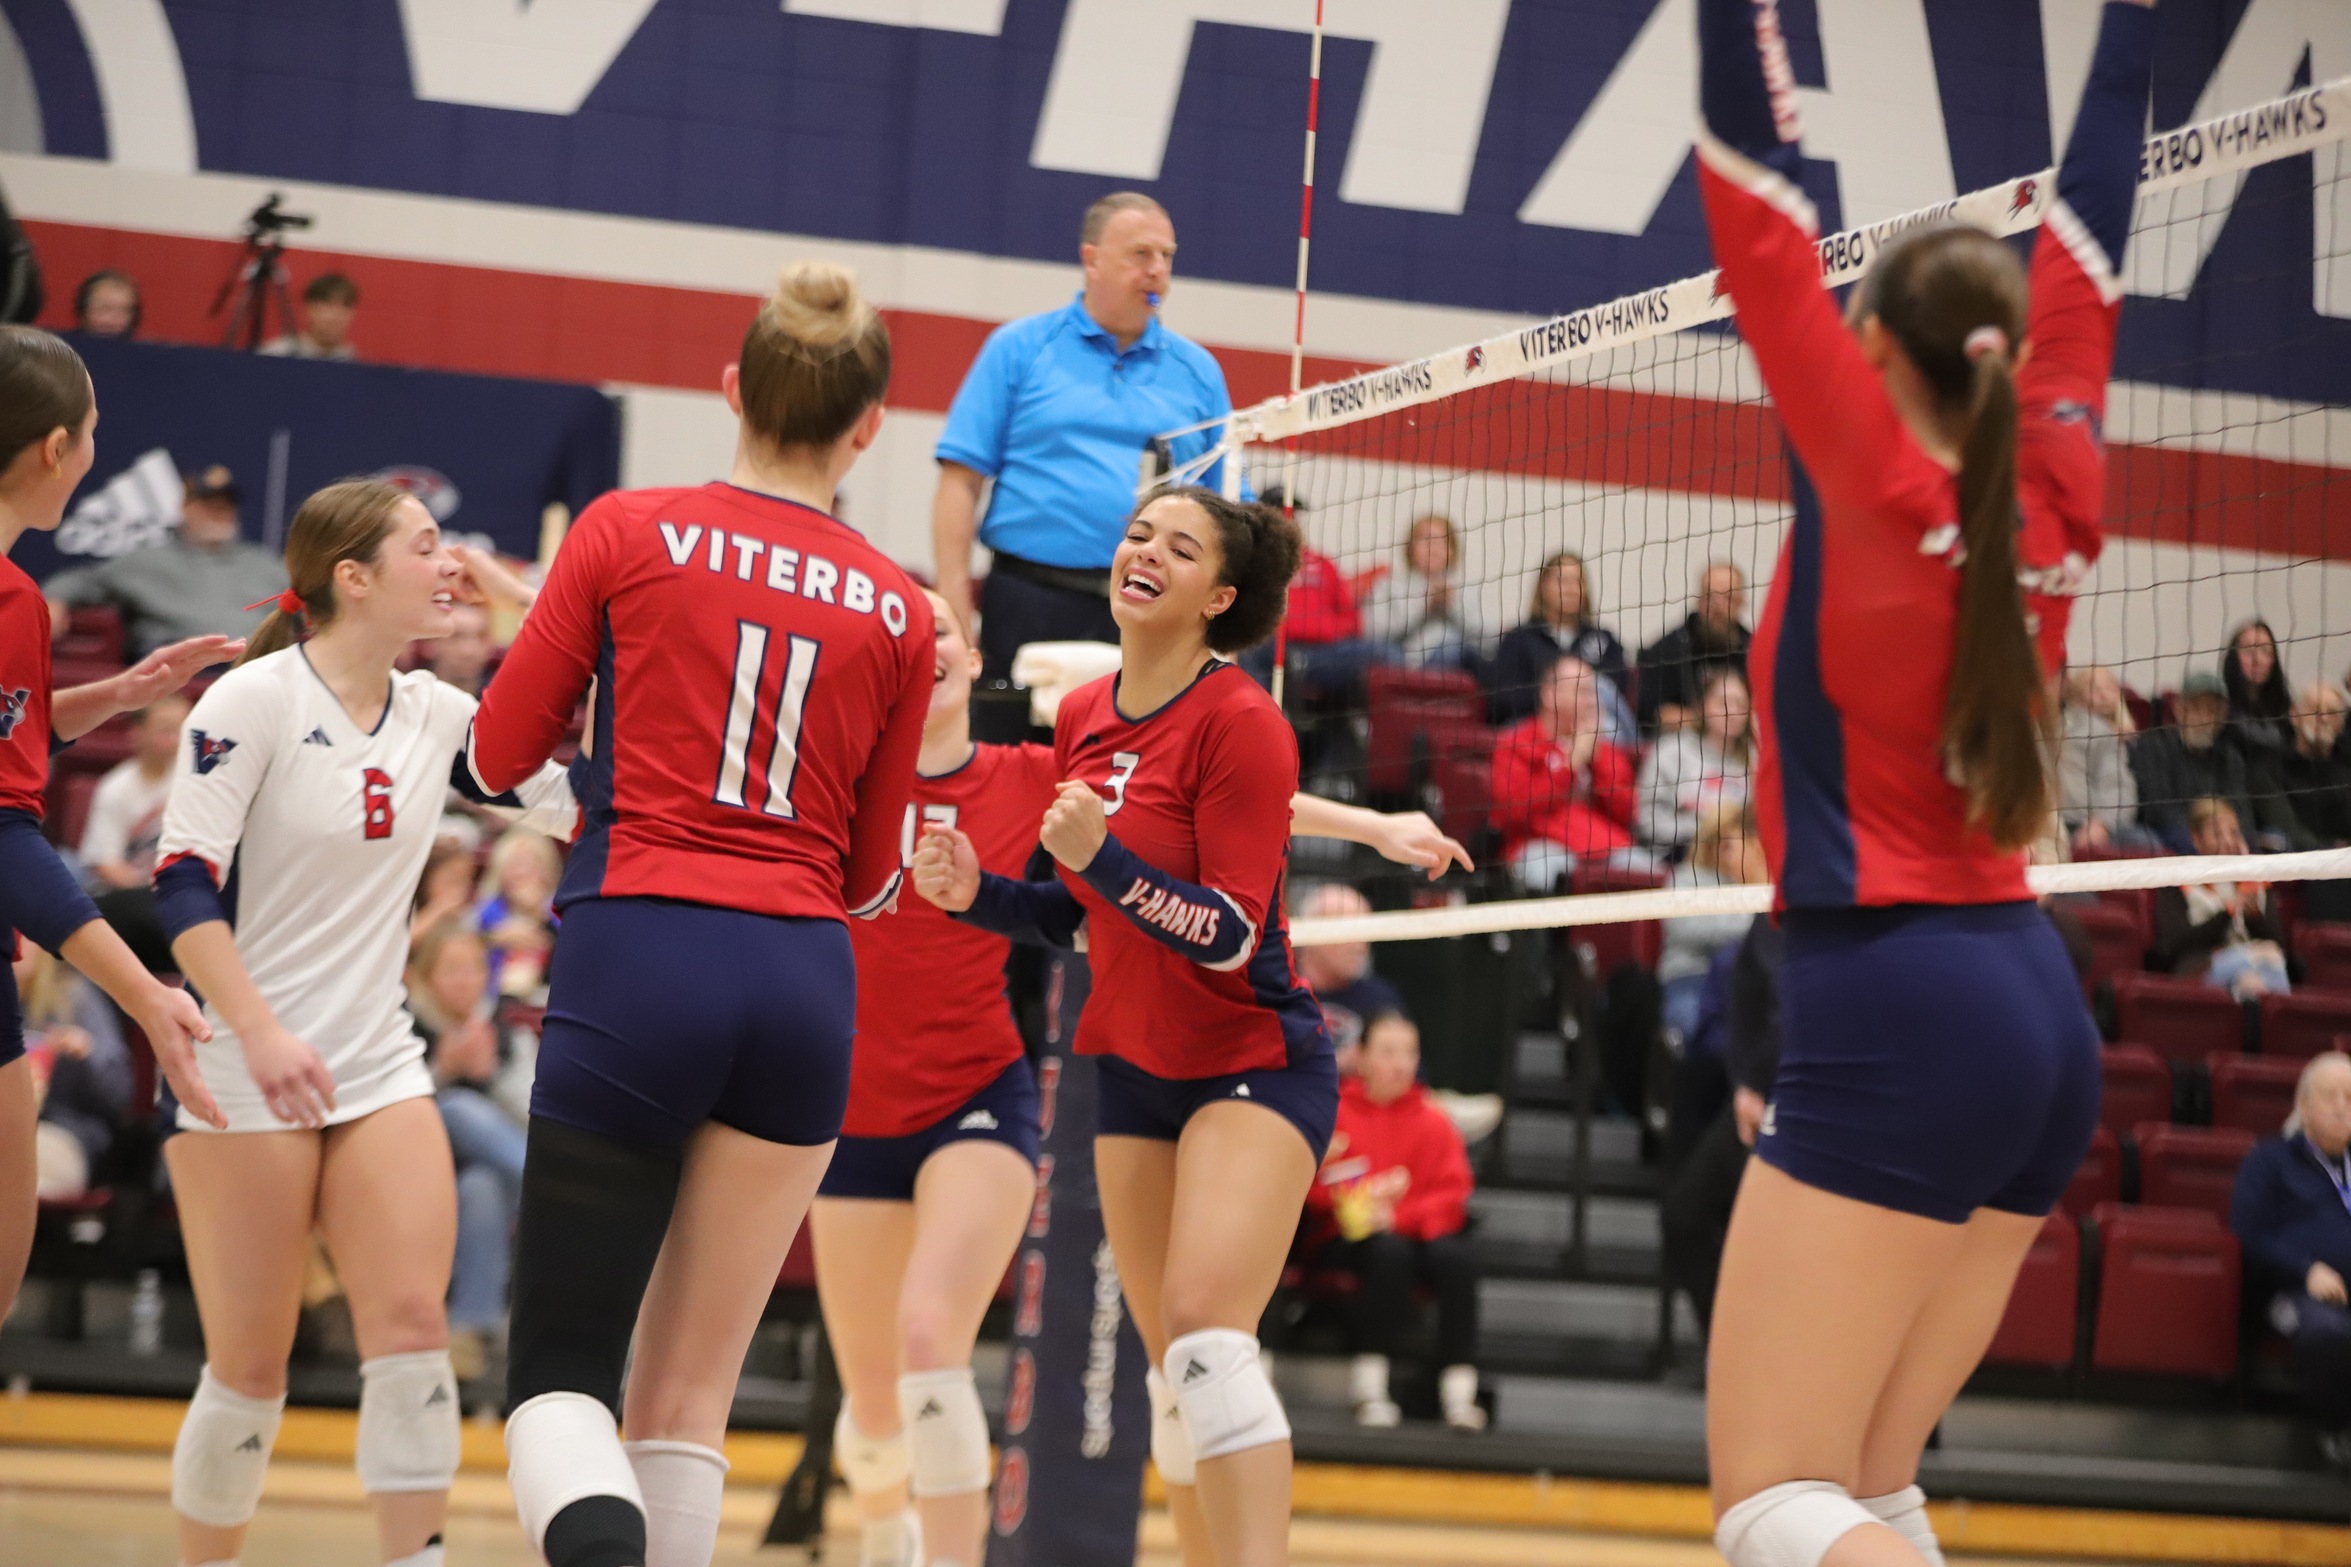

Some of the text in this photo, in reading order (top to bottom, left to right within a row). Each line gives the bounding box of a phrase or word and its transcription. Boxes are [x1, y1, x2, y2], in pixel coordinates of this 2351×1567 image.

[2208, 89, 2327, 157] V-HAWKS
[1595, 290, 1669, 338] V-HAWKS
[1371, 360, 1432, 404] V-HAWKS
[658, 522, 907, 637] VITERBO
[711, 618, 822, 822] 11
[363, 767, 395, 840] 6
[1104, 751, 1140, 816] 3
[1119, 877, 1220, 946] V-HAWKS
